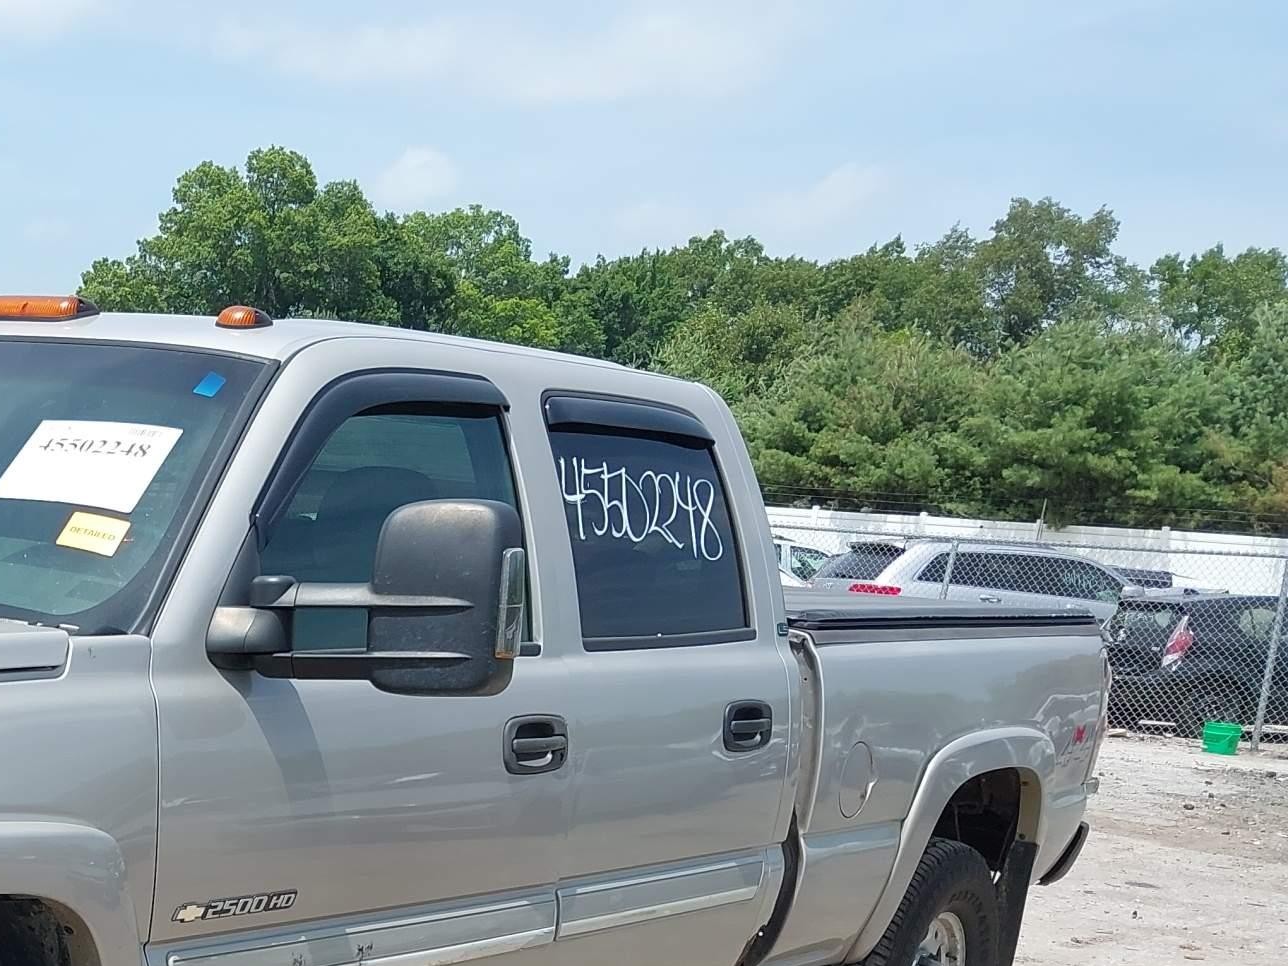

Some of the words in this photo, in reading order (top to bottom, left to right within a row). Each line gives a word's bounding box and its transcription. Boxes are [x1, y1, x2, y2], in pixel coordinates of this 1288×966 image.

[39, 438, 152, 457] 45502248
[558, 456, 724, 562] 45502248
[68, 525, 117, 541] DETAILED
[205, 895, 269, 919] 2500
[268, 893, 296, 909] HD
